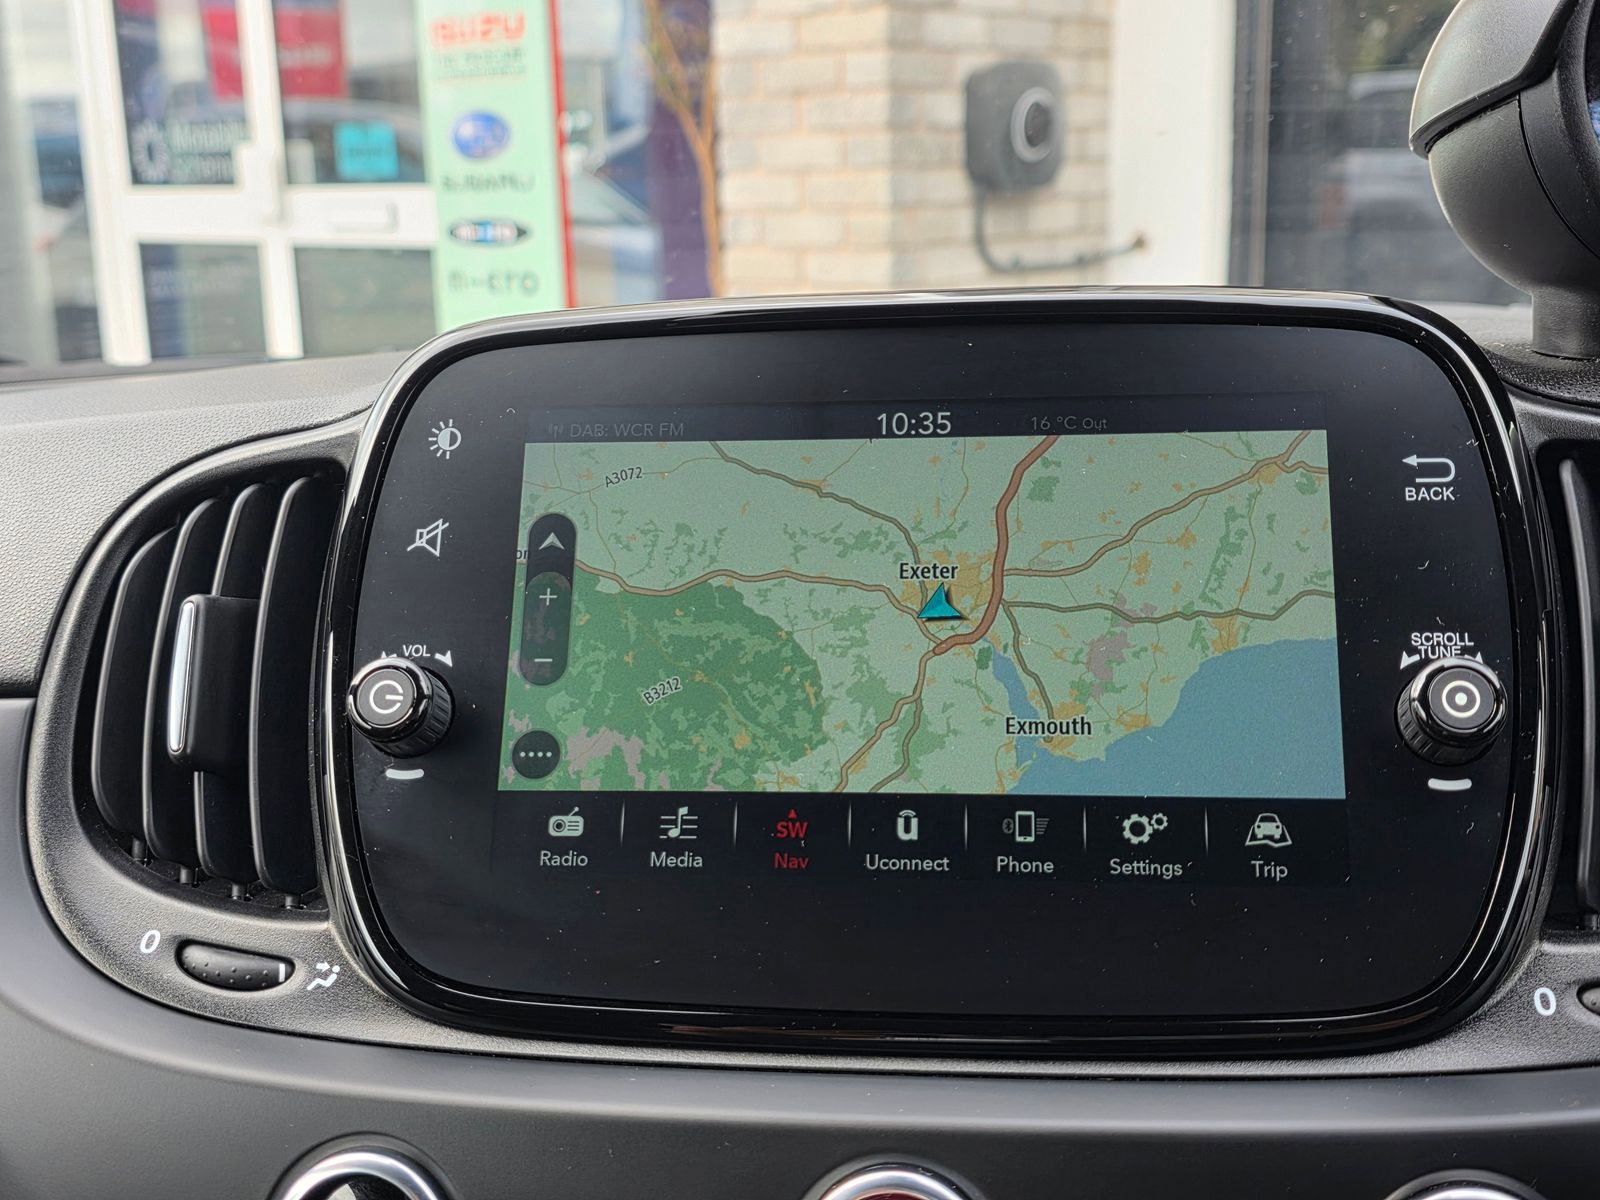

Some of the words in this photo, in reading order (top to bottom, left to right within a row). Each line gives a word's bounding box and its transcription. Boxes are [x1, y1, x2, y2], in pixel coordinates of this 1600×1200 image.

[570, 423, 609, 437] DAB:
[614, 423, 654, 437] WCR
[659, 422, 684, 436] FM
[877, 412, 952, 435] 10:35
[1031, 416, 1051, 430] 16
[1082, 417, 1108, 430] Out
[605, 466, 643, 488] A3072
[1405, 487, 1455, 501] BACK
[899, 562, 958, 580] Exeter
[1411, 631, 1475, 647] SCROLL
[402, 643, 431, 658] VOL
[1418, 645, 1462, 659] TUNE
[643, 677, 681, 704] B3212
[1005, 716, 1092, 736] Exmouth
[539, 850, 589, 867] Radio
[650, 850, 703, 868] Media
[774, 852, 809, 869] Nav
[865, 853, 950, 872] Uconnect
[996, 855, 1054, 873] Phone
[1109, 858, 1183, 880] Settings
[1250, 860, 1289, 880] Trip
